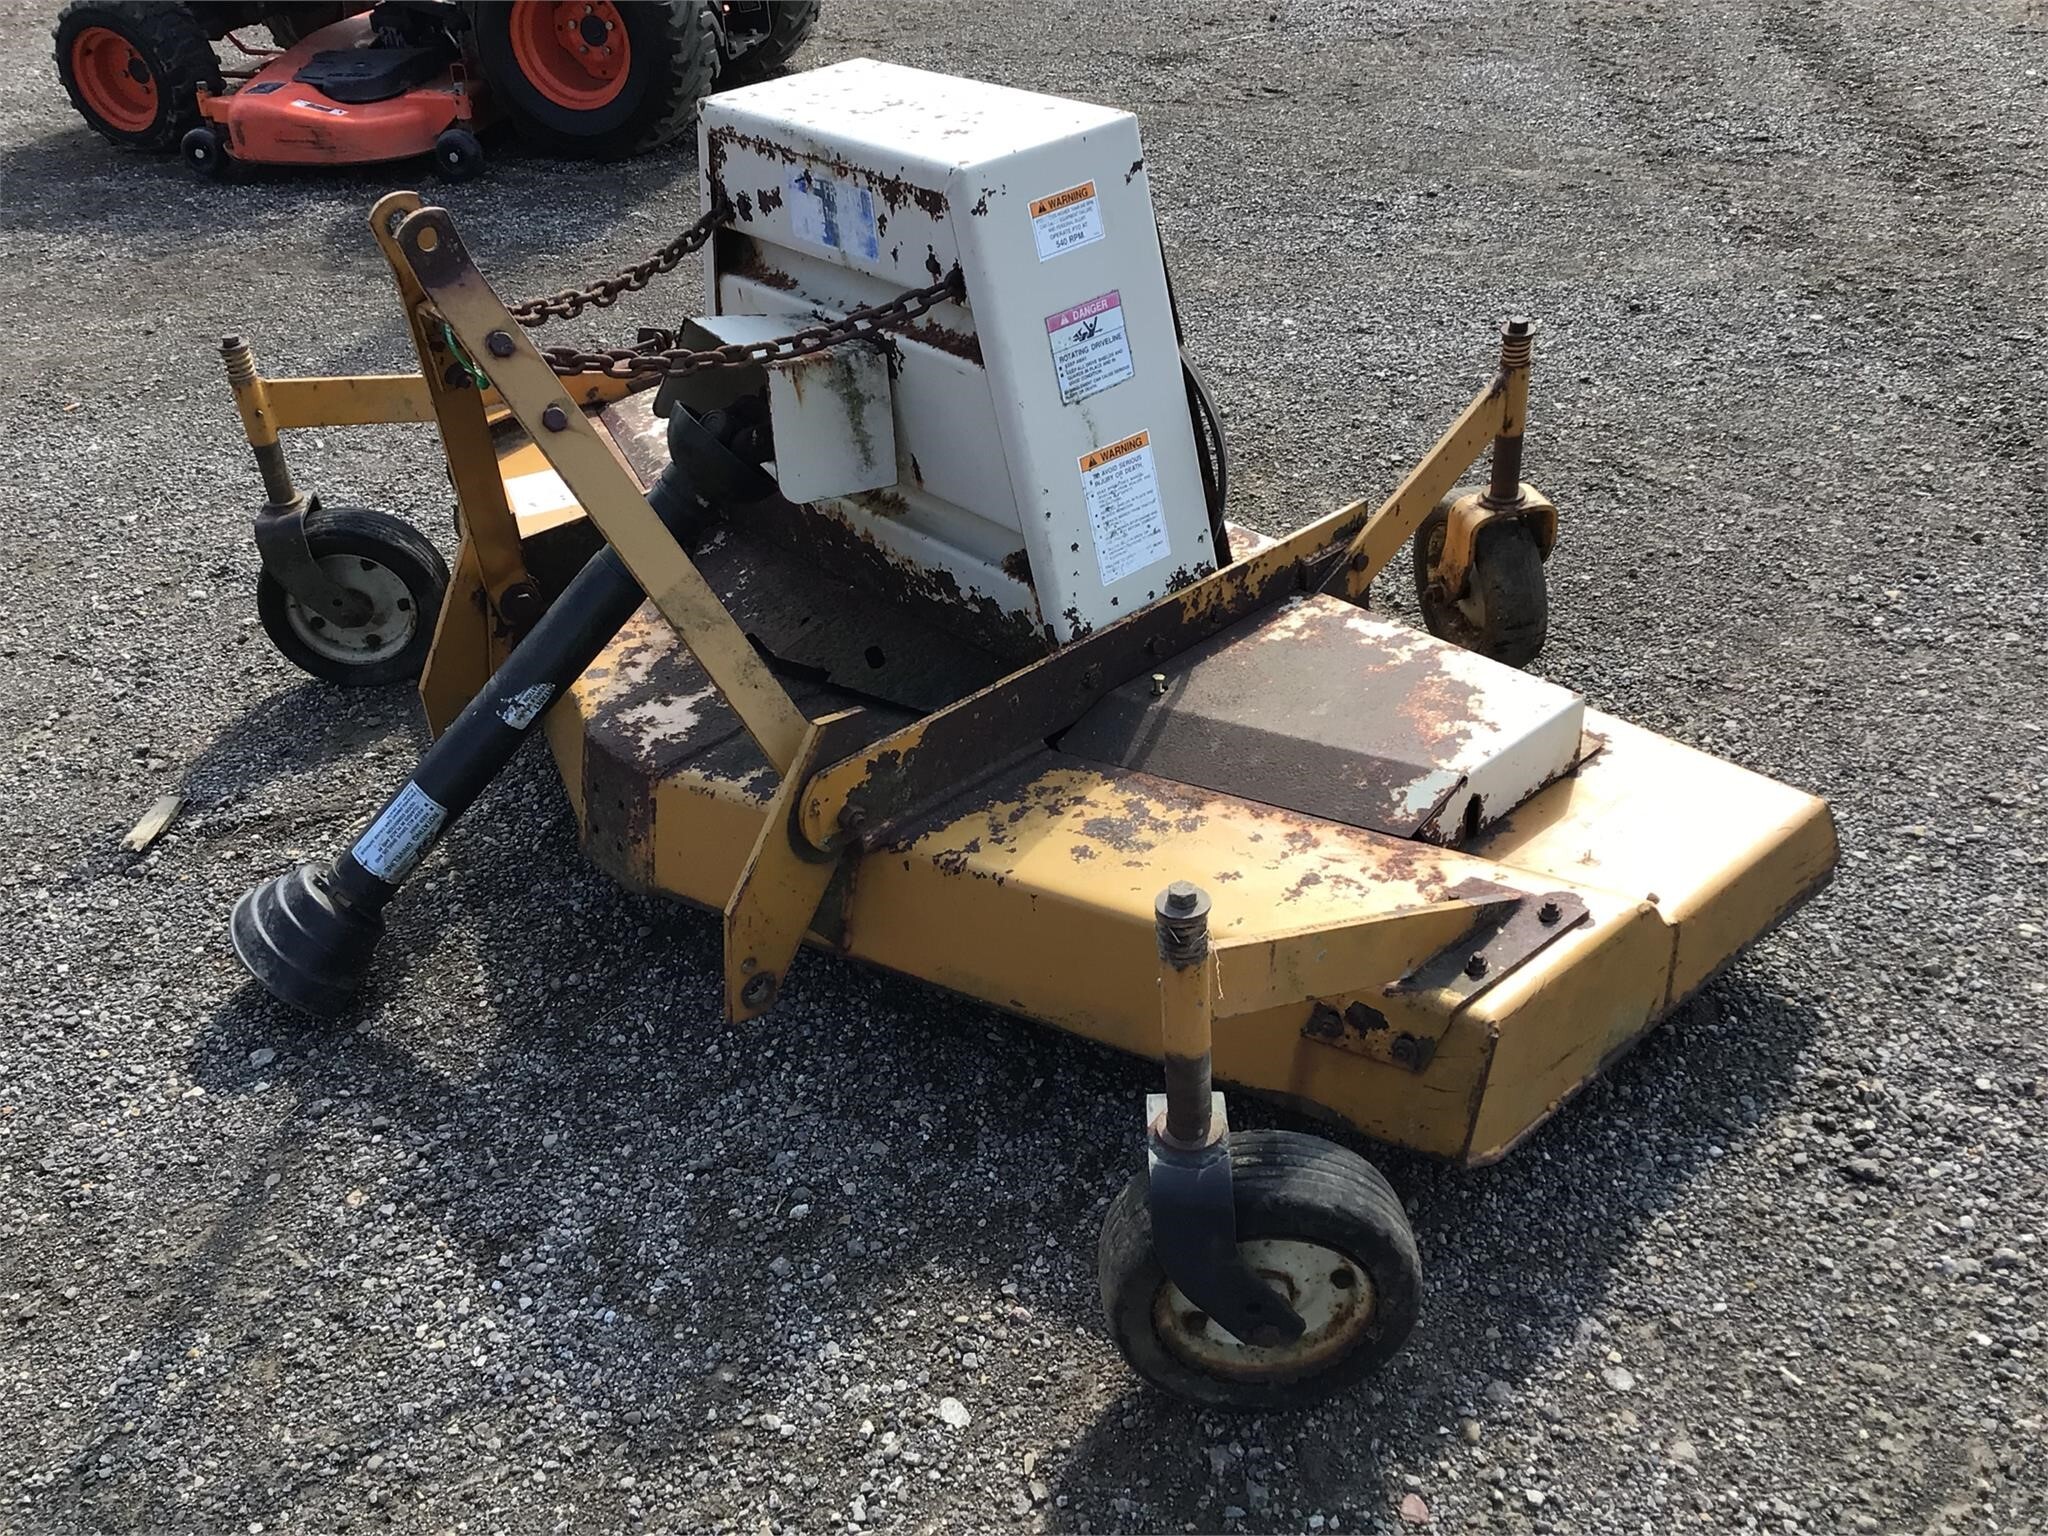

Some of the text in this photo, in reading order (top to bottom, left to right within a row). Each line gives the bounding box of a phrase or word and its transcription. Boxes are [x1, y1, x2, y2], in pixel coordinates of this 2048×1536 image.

[1048, 187, 1088, 209] WARNING
[1055, 237, 1068, 249] 540
[1069, 231, 1084, 243] RPM
[1072, 299, 1108, 320] DANGER
[1059, 332, 1122, 363] ROTATING DRIVELINE
[1100, 437, 1142, 461] WARNING
[1101, 465, 1118, 476] AVOID
[1119, 454, 1142, 469] SERIOUS
[1095, 474, 1114, 487] INJURY
[1115, 470, 1123, 479] OR
